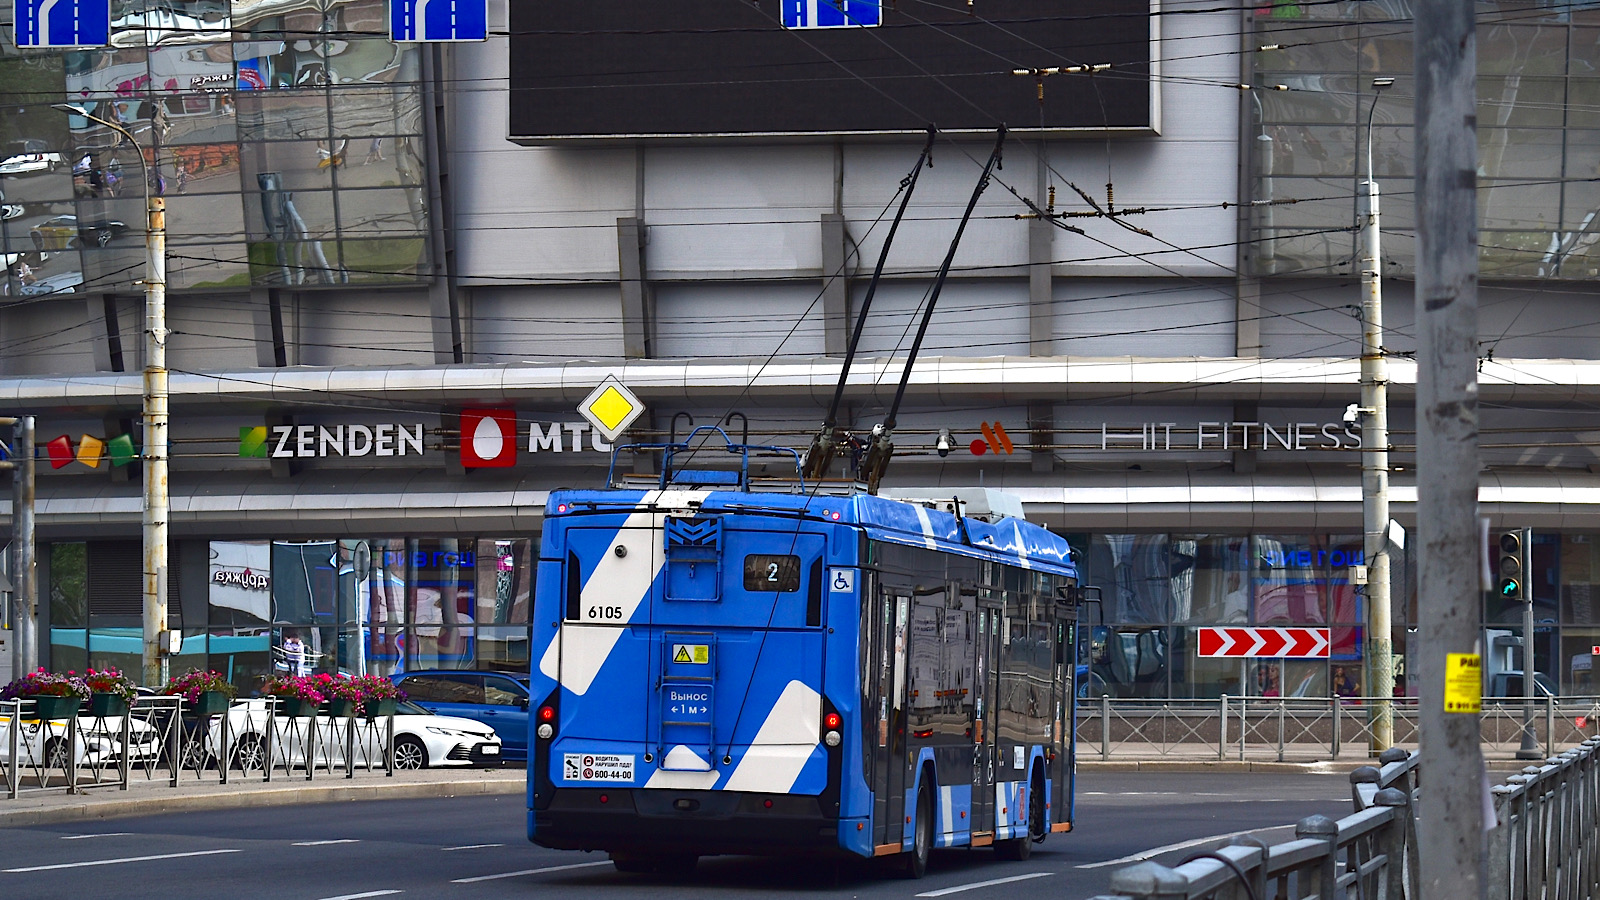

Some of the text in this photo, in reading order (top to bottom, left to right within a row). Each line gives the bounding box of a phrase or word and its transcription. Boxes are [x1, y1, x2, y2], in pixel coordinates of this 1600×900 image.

[272, 424, 423, 458] ZENDEN
[1102, 421, 1362, 450] HIT FITNESS
[768, 563, 778, 582] 2
[588, 605, 623, 619] 6105
[670, 691, 708, 701] Вынос
[680, 703, 698, 714] 1 м
[595, 770, 632, 779] 600-44-00
